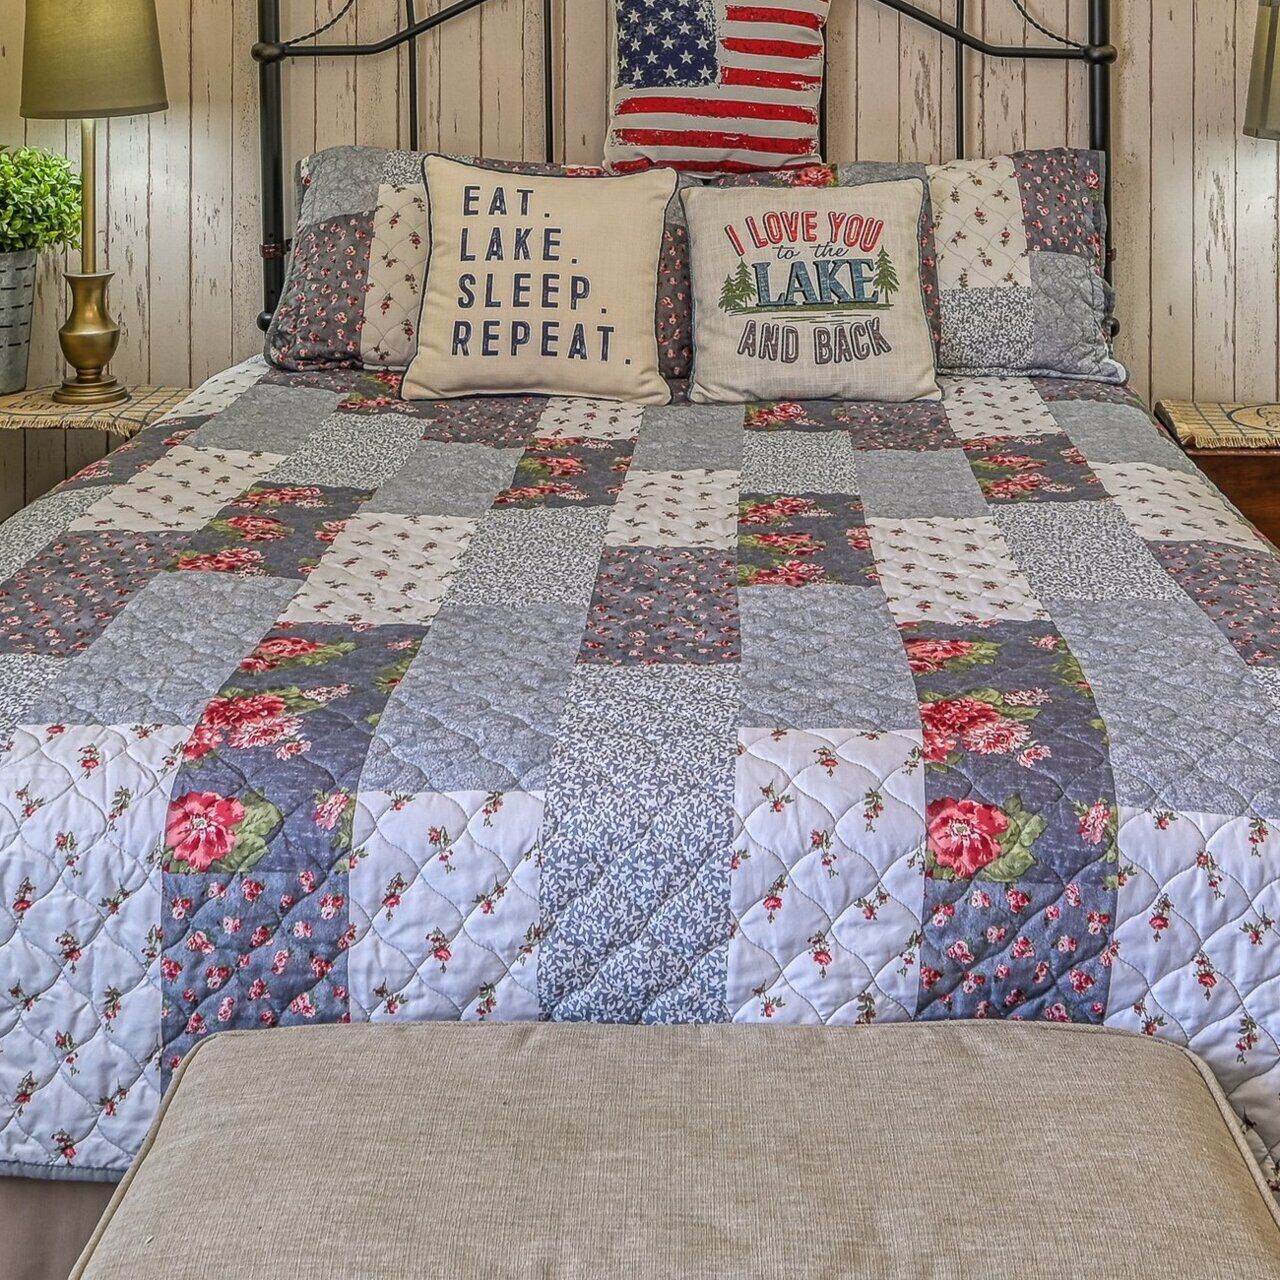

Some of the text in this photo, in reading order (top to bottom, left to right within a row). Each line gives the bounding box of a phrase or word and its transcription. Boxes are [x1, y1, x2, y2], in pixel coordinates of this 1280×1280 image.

[463, 185, 550, 218] EAT.
[460, 226, 578, 264] LAKE.
[724, 210, 884, 257] I LOVE YOU
[772, 241, 850, 260] to the
[457, 273, 607, 314] SLEEP.
[751, 258, 879, 307] LAKE
[451, 320, 631, 365] REPEAT.
[737, 316, 893, 365] AND BACK
